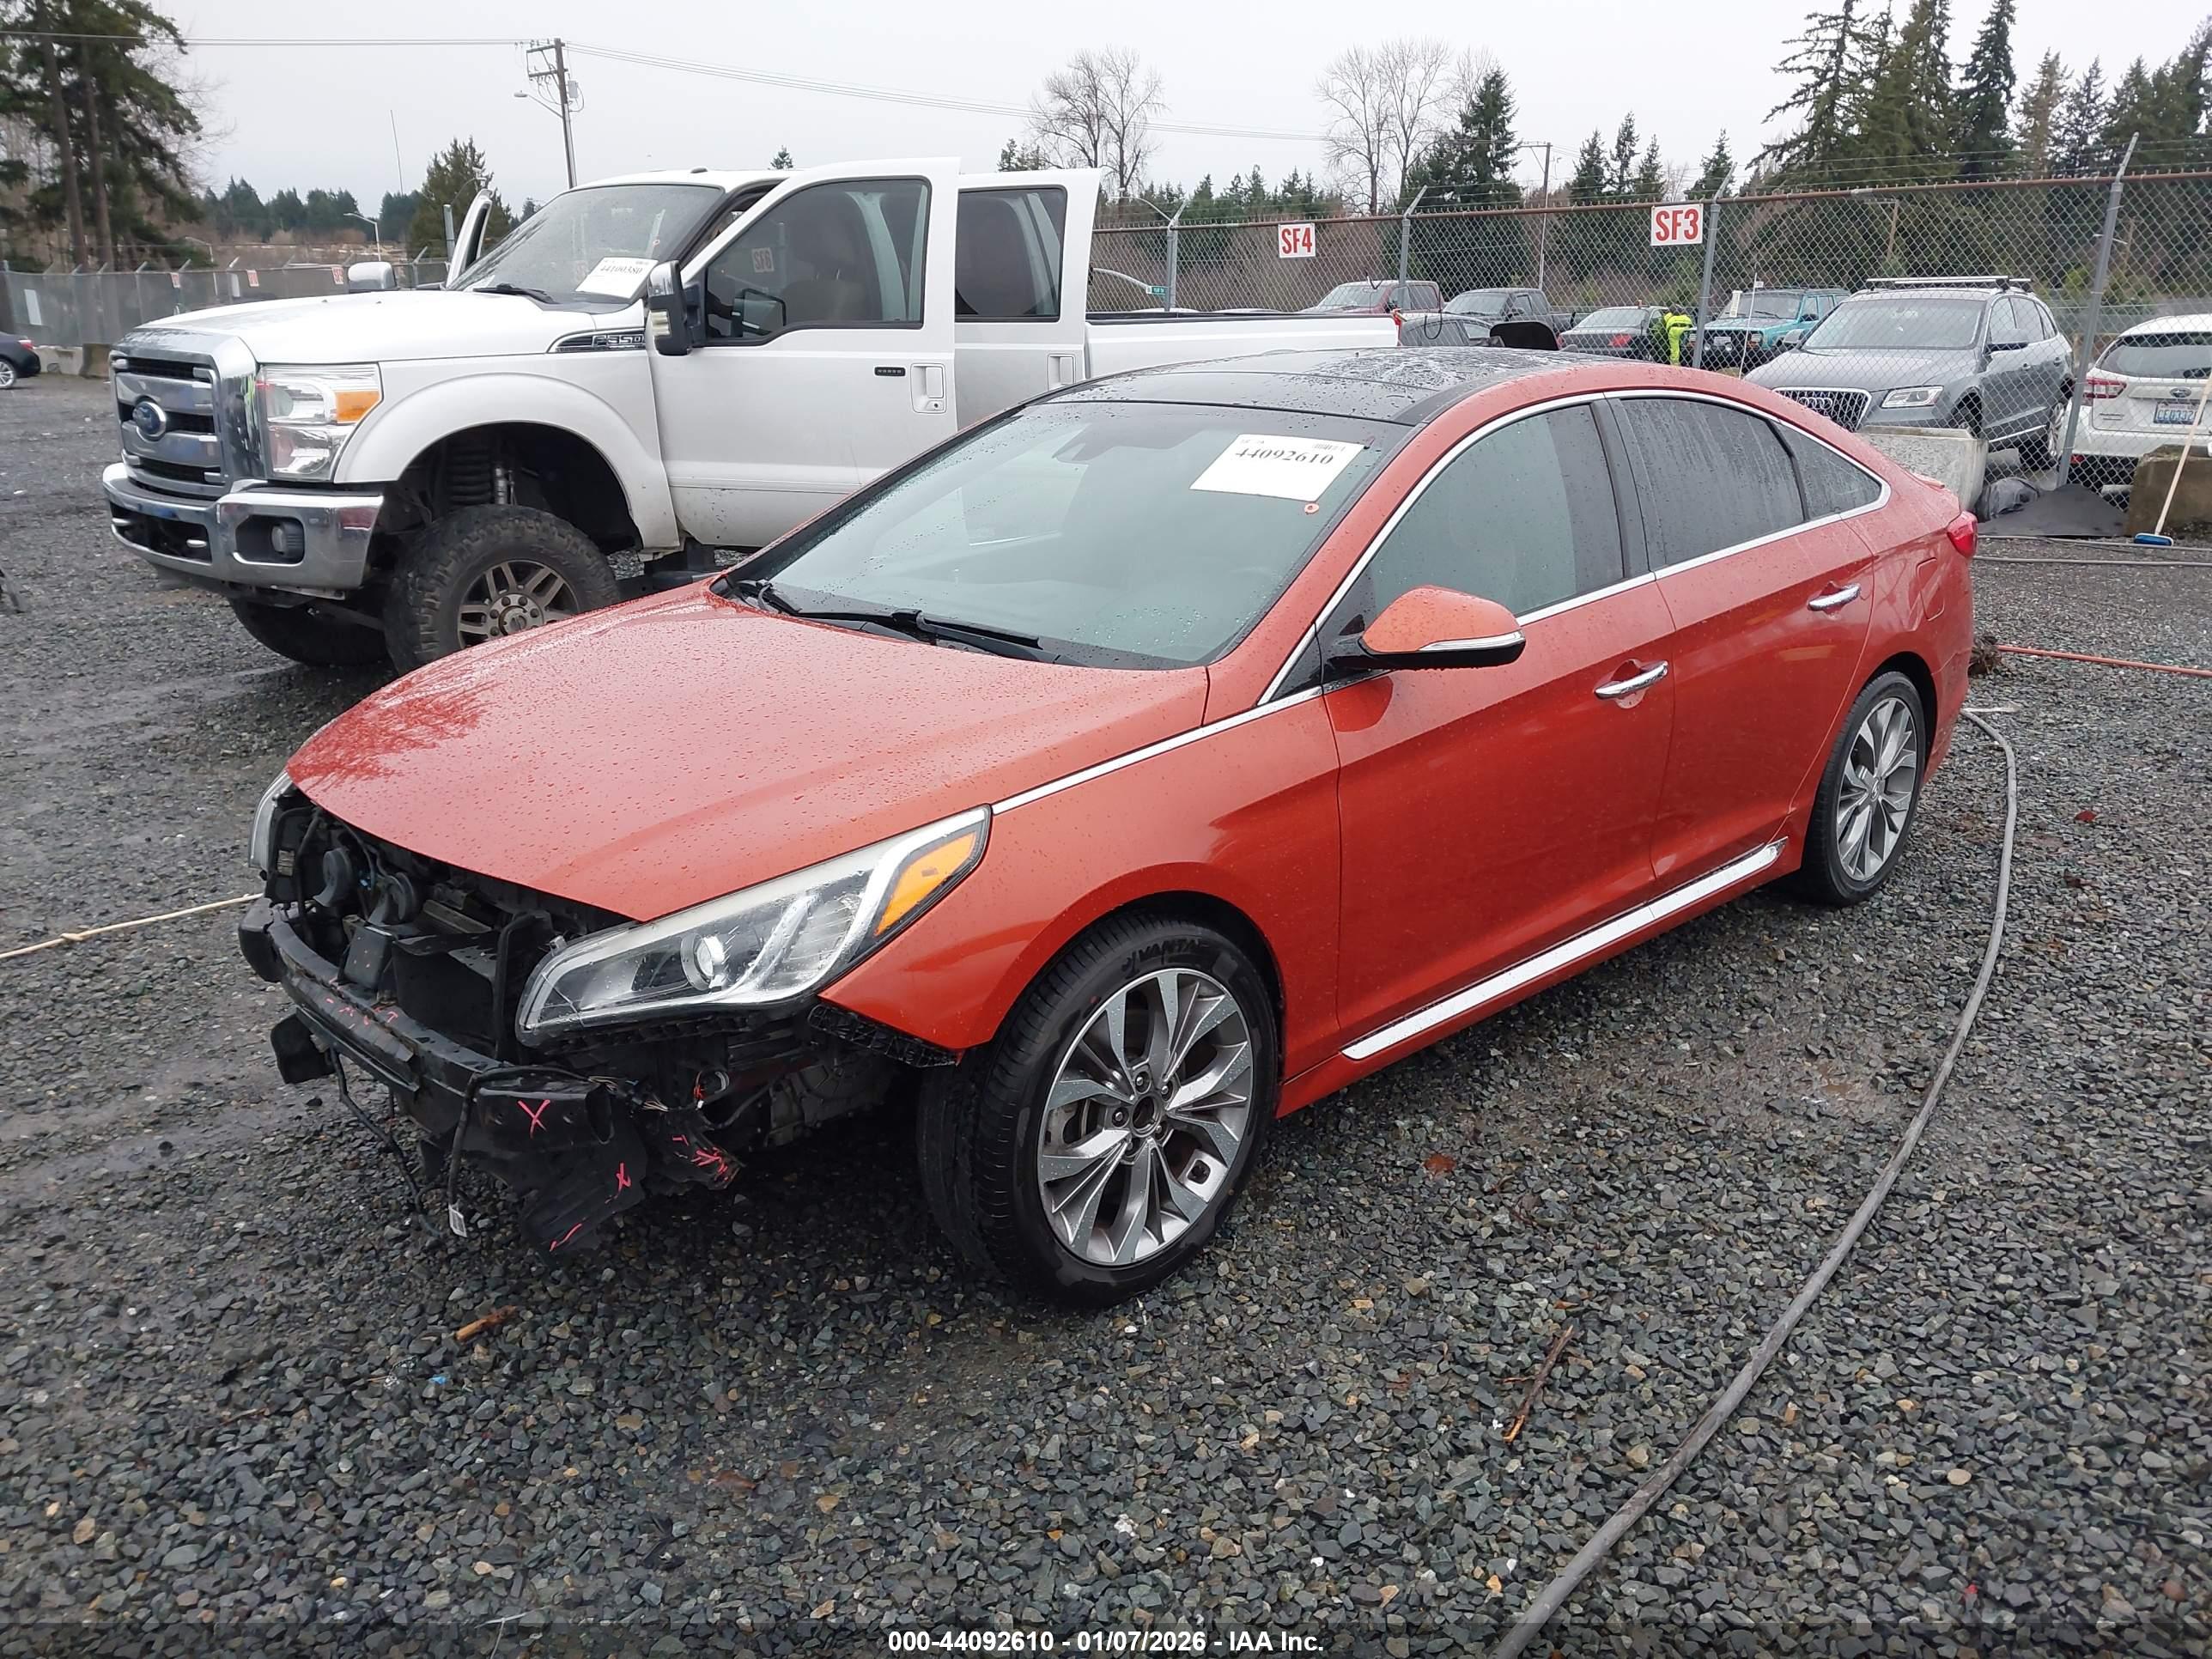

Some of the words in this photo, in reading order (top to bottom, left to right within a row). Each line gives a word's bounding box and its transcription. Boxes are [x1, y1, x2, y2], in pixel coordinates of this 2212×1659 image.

[1656, 209, 1699, 241] SF3
[1281, 228, 1313, 254] SF4
[1235, 447, 1334, 465] 44092610
